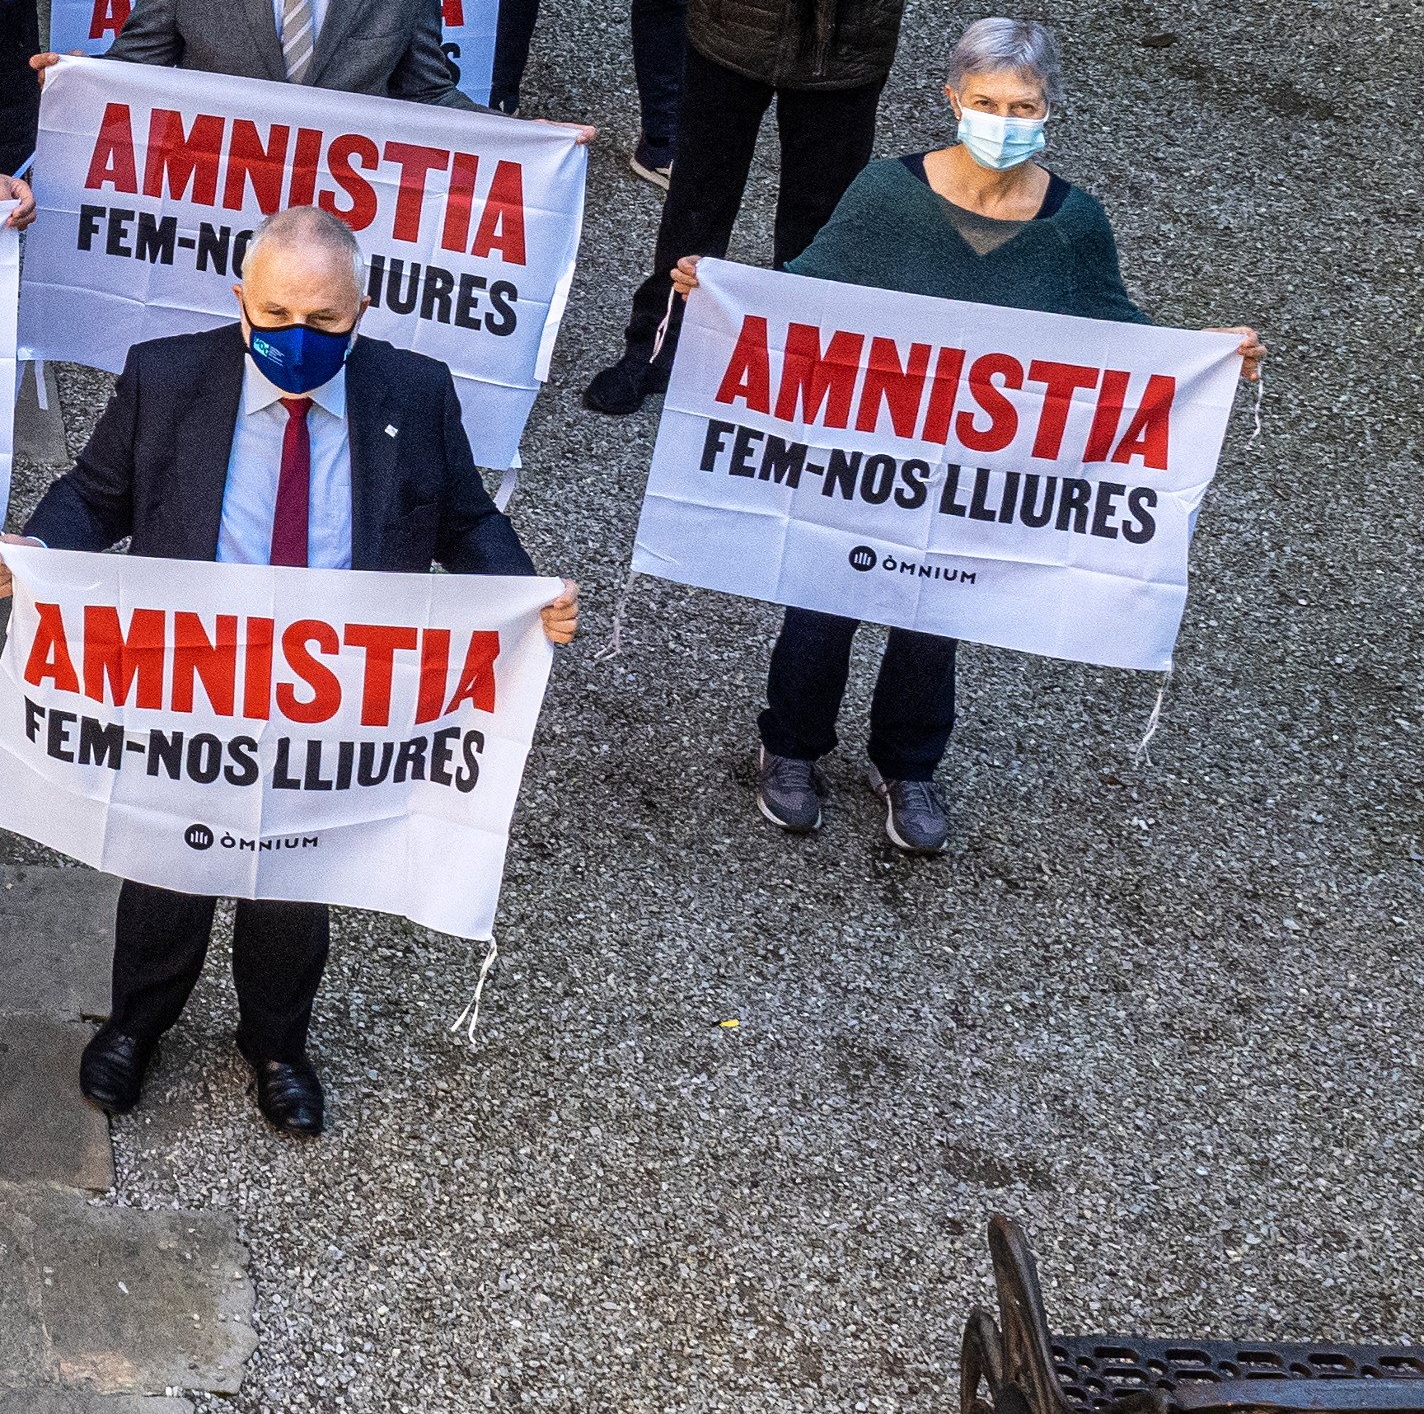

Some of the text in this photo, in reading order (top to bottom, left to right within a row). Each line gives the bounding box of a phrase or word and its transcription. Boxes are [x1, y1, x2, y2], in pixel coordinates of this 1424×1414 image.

[84, 102, 527, 266] AMNISTIA
[77, 203, 518, 337] FEM-N IURES
[715, 314, 1176, 471] AMNISTIA
[699, 419, 1158, 545] FEM-NOS LLIURES
[883, 554, 977, 585] ÒMNIUM
[24, 602, 501, 726] AMNISTIA
[24, 695, 485, 792] FEM-NOS LLIURES
[220, 831, 319, 850] ÒMNIUM
